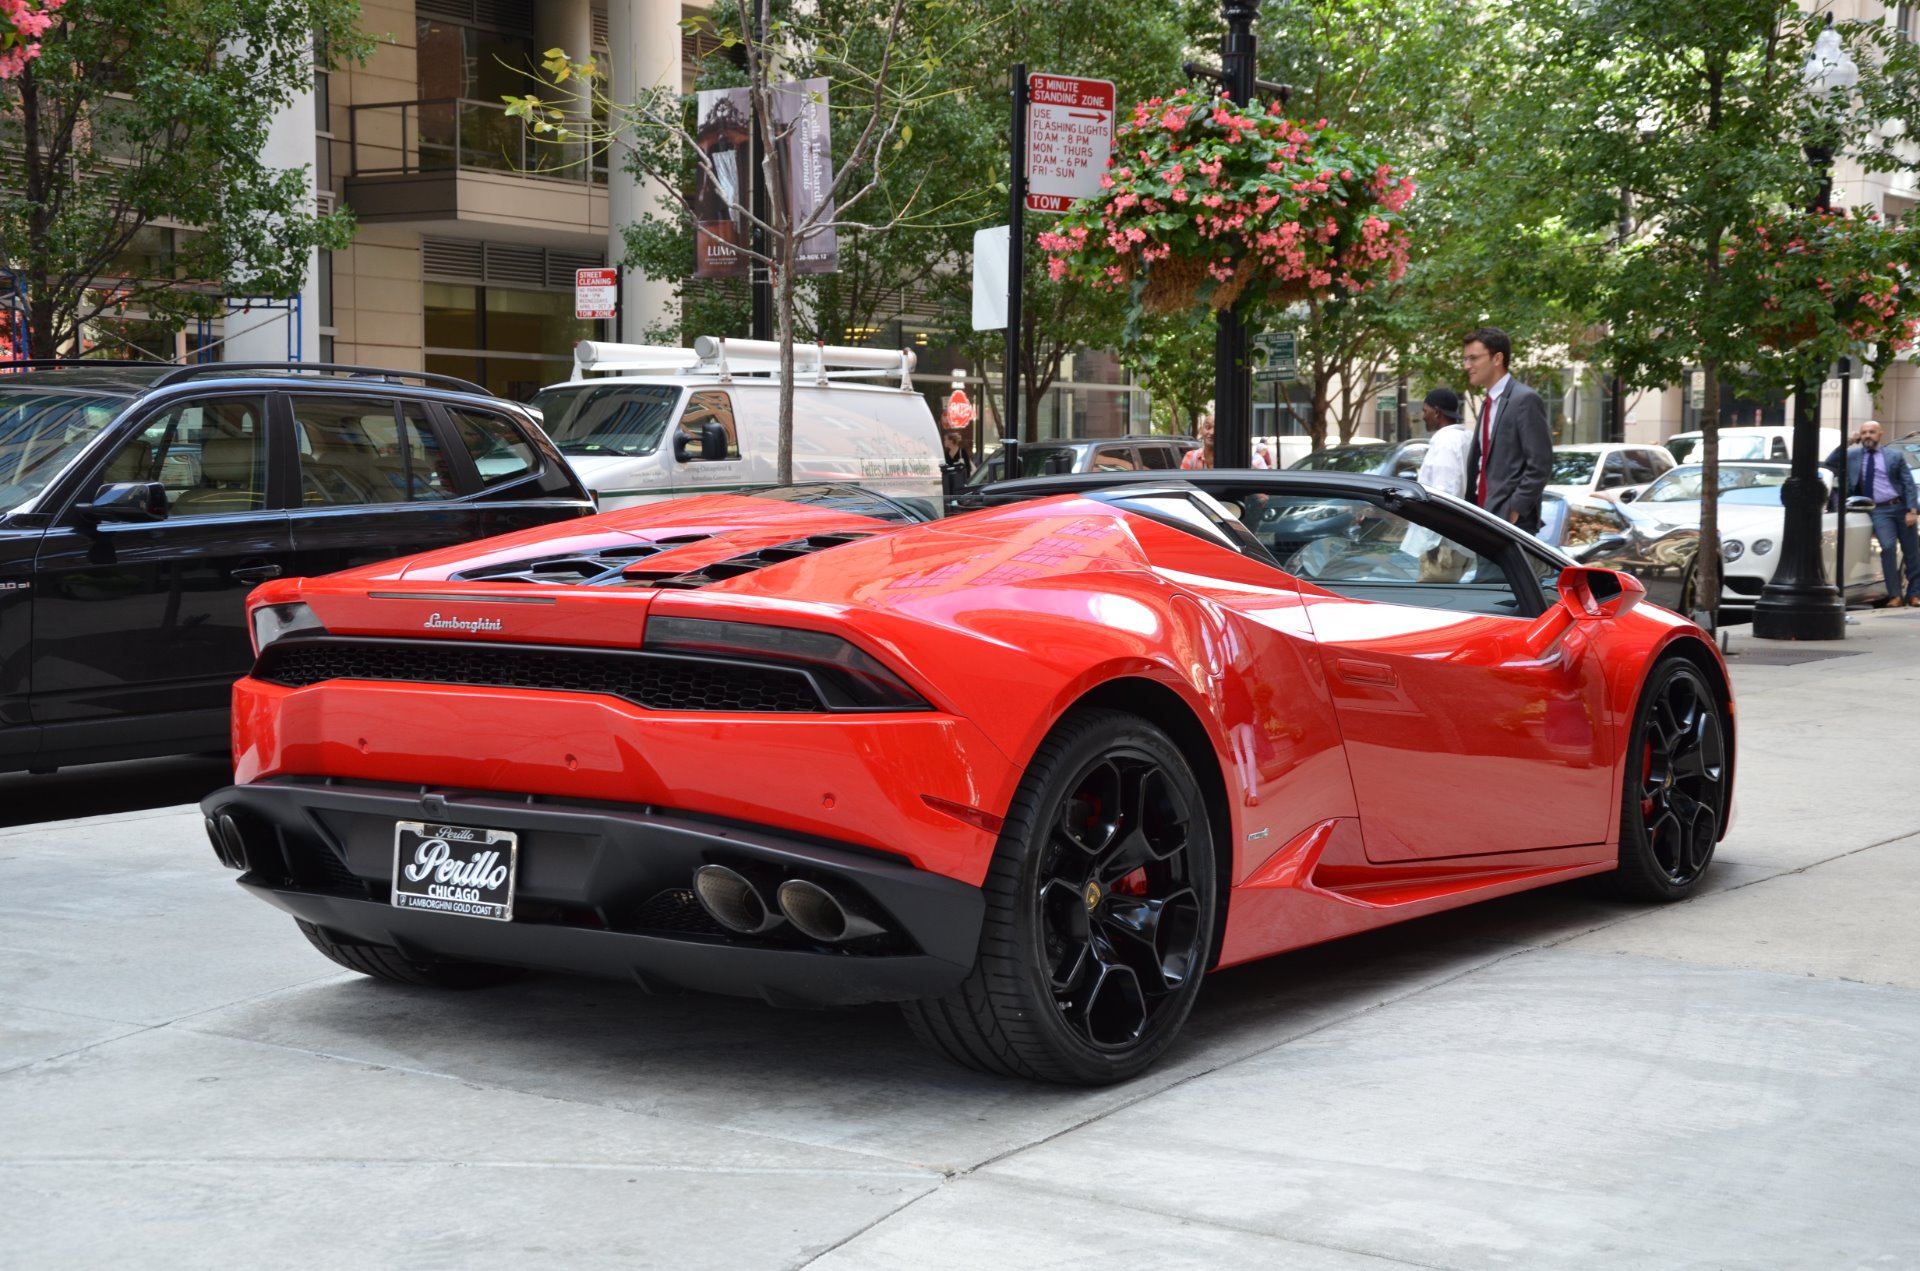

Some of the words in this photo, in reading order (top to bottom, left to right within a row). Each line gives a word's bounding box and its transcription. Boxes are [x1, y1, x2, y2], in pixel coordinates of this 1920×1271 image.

[1034, 78, 1044, 89] 15
[1046, 80, 1079, 93] MINUTE
[1034, 90, 1077, 105] STANDING
[1081, 95, 1105, 107] ZONE
[1034, 109, 1051, 119] USE
[1033, 120, 1077, 134] FLASHING
[1078, 125, 1108, 137] LIGHTS
[1033, 131, 1043, 141] 10
[1044, 132, 1059, 143] AM
[1067, 135, 1073, 145] 8
[1076, 135, 1090, 145] PM
[801, 118, 810, 191] Confessionals
[1033, 143, 1053, 153] MON
[1063, 145, 1094, 157] THURS
[1033, 154, 1042, 164] 10
[1043, 155, 1057, 165] AM
[1066, 157, 1072, 166] 6
[1074, 158, 1088, 168] PM
[1032, 165, 1048, 176] FRI
[1056, 167, 1075, 178] SUN
[1032, 196, 1061, 210] TOW
[707, 245, 736, 256] LUMA
[579, 271, 602, 279] STREET
[423, 612, 503, 633] Lamborghini
[435, 826, 475, 840] Perillo
[404, 839, 508, 891] Perillo
[428, 884, 480, 902] CHICAGO
[408, 897, 452, 911] LAMBORGHINI
[453, 901, 471, 913] GOLD
[471, 904, 492, 915] COAST
